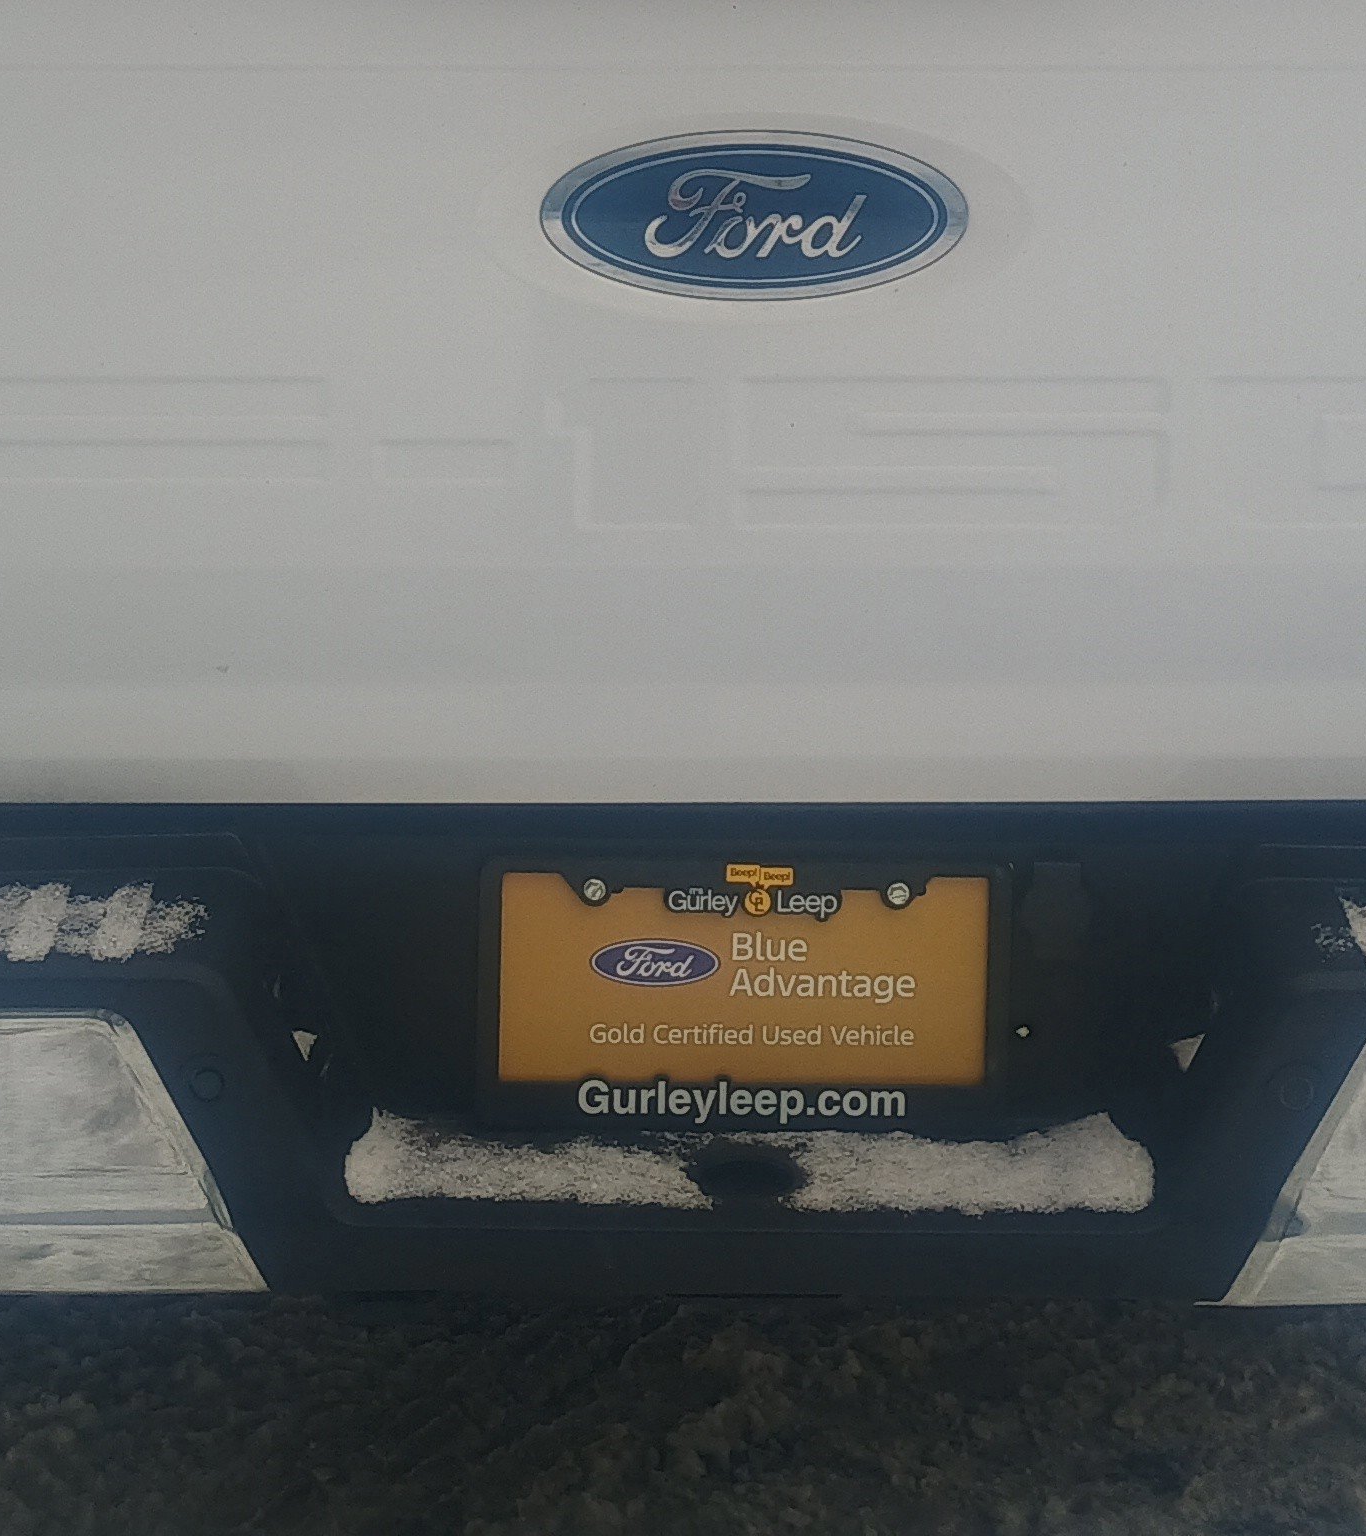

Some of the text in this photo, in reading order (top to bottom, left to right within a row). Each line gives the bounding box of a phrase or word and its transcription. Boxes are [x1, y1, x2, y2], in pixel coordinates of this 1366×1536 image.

[644, 168, 867, 259] Ford
[730, 867, 791, 883] Beep! Beep!
[668, 889, 738, 917] Gurley
[777, 889, 838, 919] Leep
[616, 945, 693, 978] Ford
[731, 931, 808, 962] Blue
[729, 967, 916, 1004] Advantage
[589, 1022, 915, 1047] Gold Certified Used Vehicle
[578, 1078, 907, 1125] Gurleyleep.com
